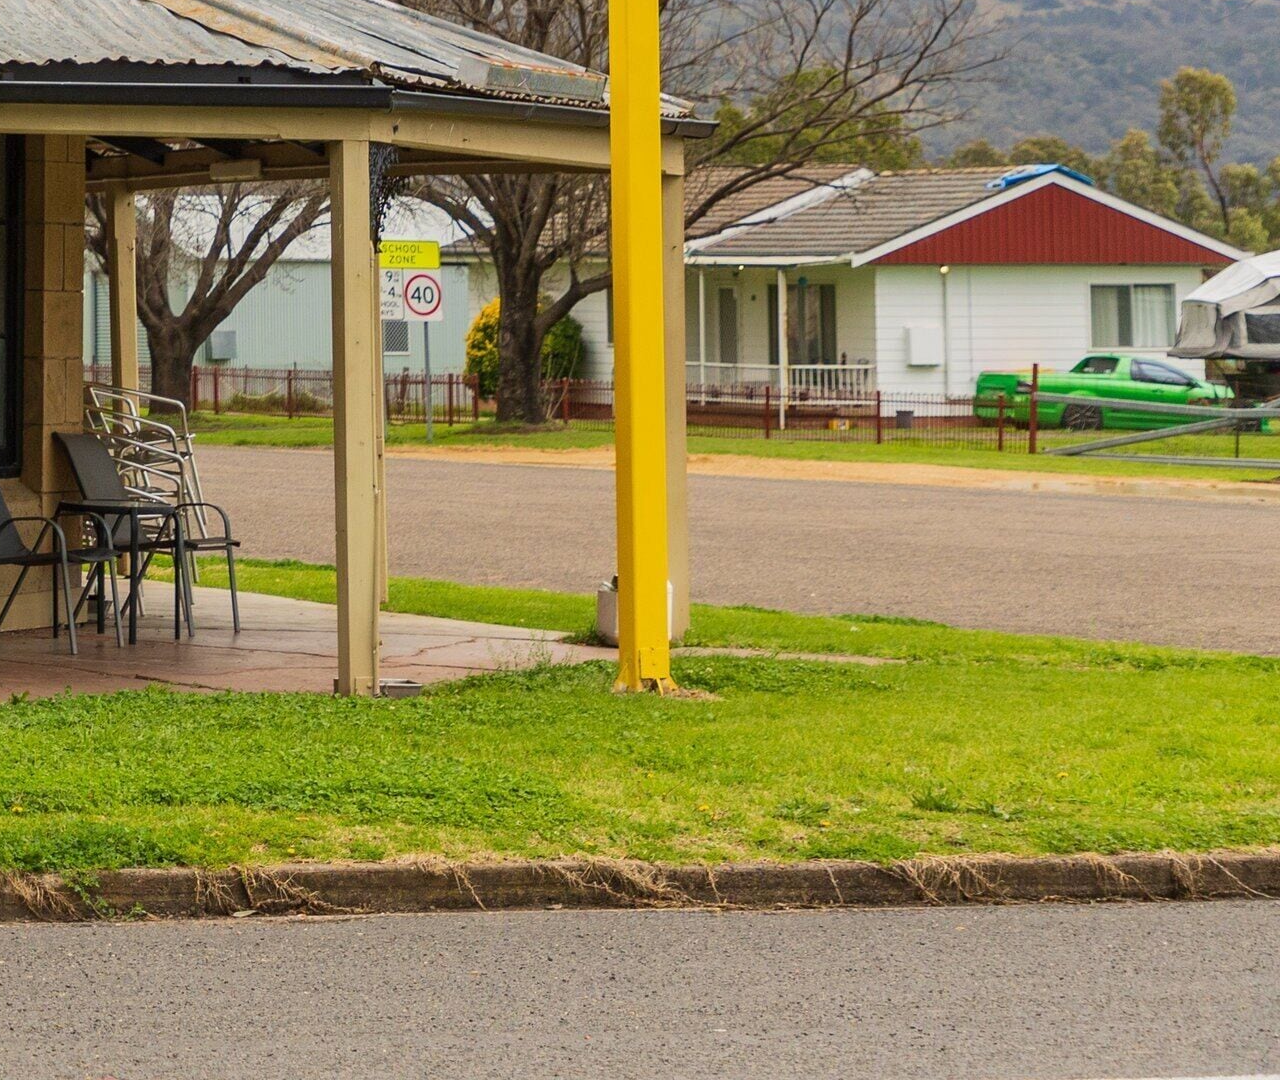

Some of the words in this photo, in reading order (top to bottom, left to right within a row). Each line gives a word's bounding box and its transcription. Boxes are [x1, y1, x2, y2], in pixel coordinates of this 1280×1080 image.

[382, 243, 423, 253] SCHOOL
[389, 255, 417, 264] ZONE
[410, 285, 434, 304] 40
[381, 300, 400, 308] HOOL
